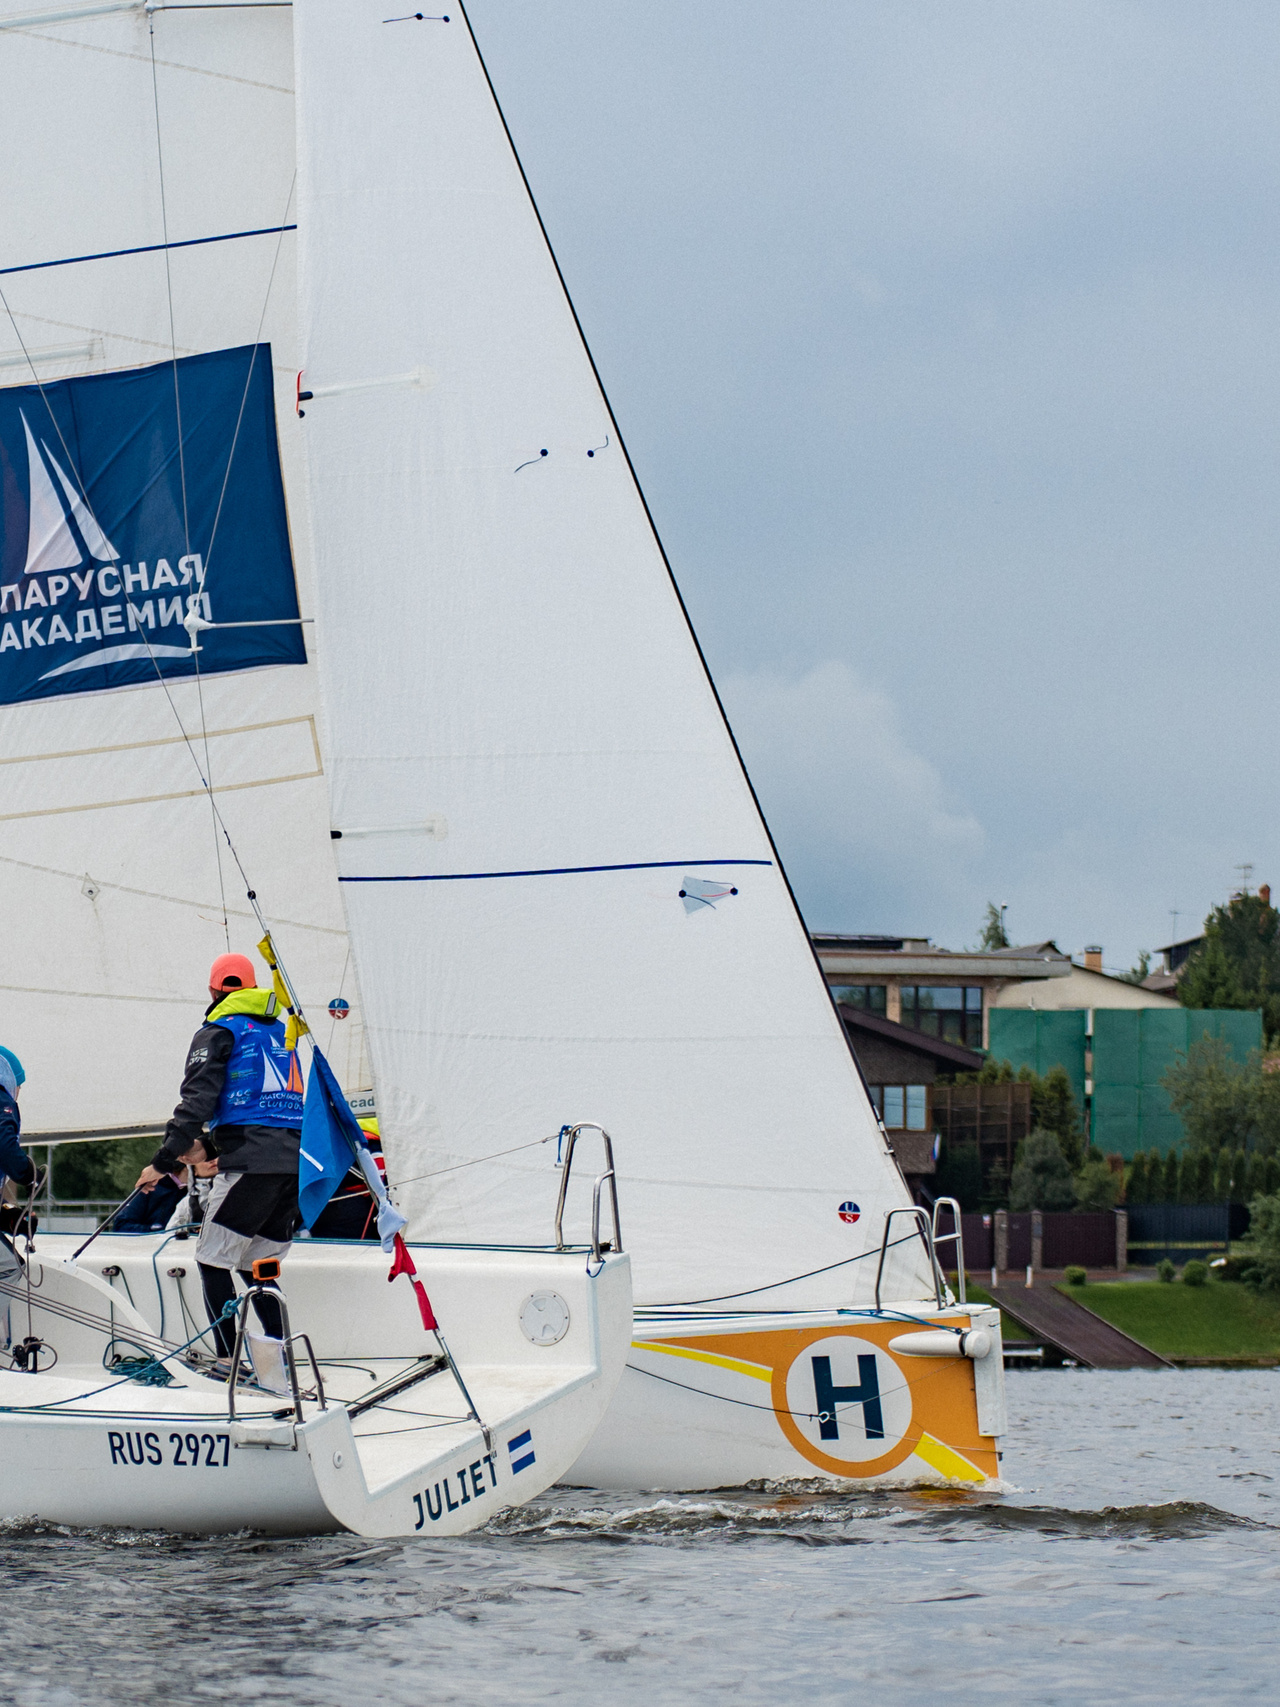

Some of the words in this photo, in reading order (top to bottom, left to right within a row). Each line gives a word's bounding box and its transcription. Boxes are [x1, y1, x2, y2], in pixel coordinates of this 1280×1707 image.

[0, 552, 205, 614] ПАРУСНАЯ
[811, 1353, 885, 1441] H
[107, 1431, 163, 1466] RUS
[168, 1433, 231, 1467] 2927
[412, 1453, 498, 1531] JULIET
